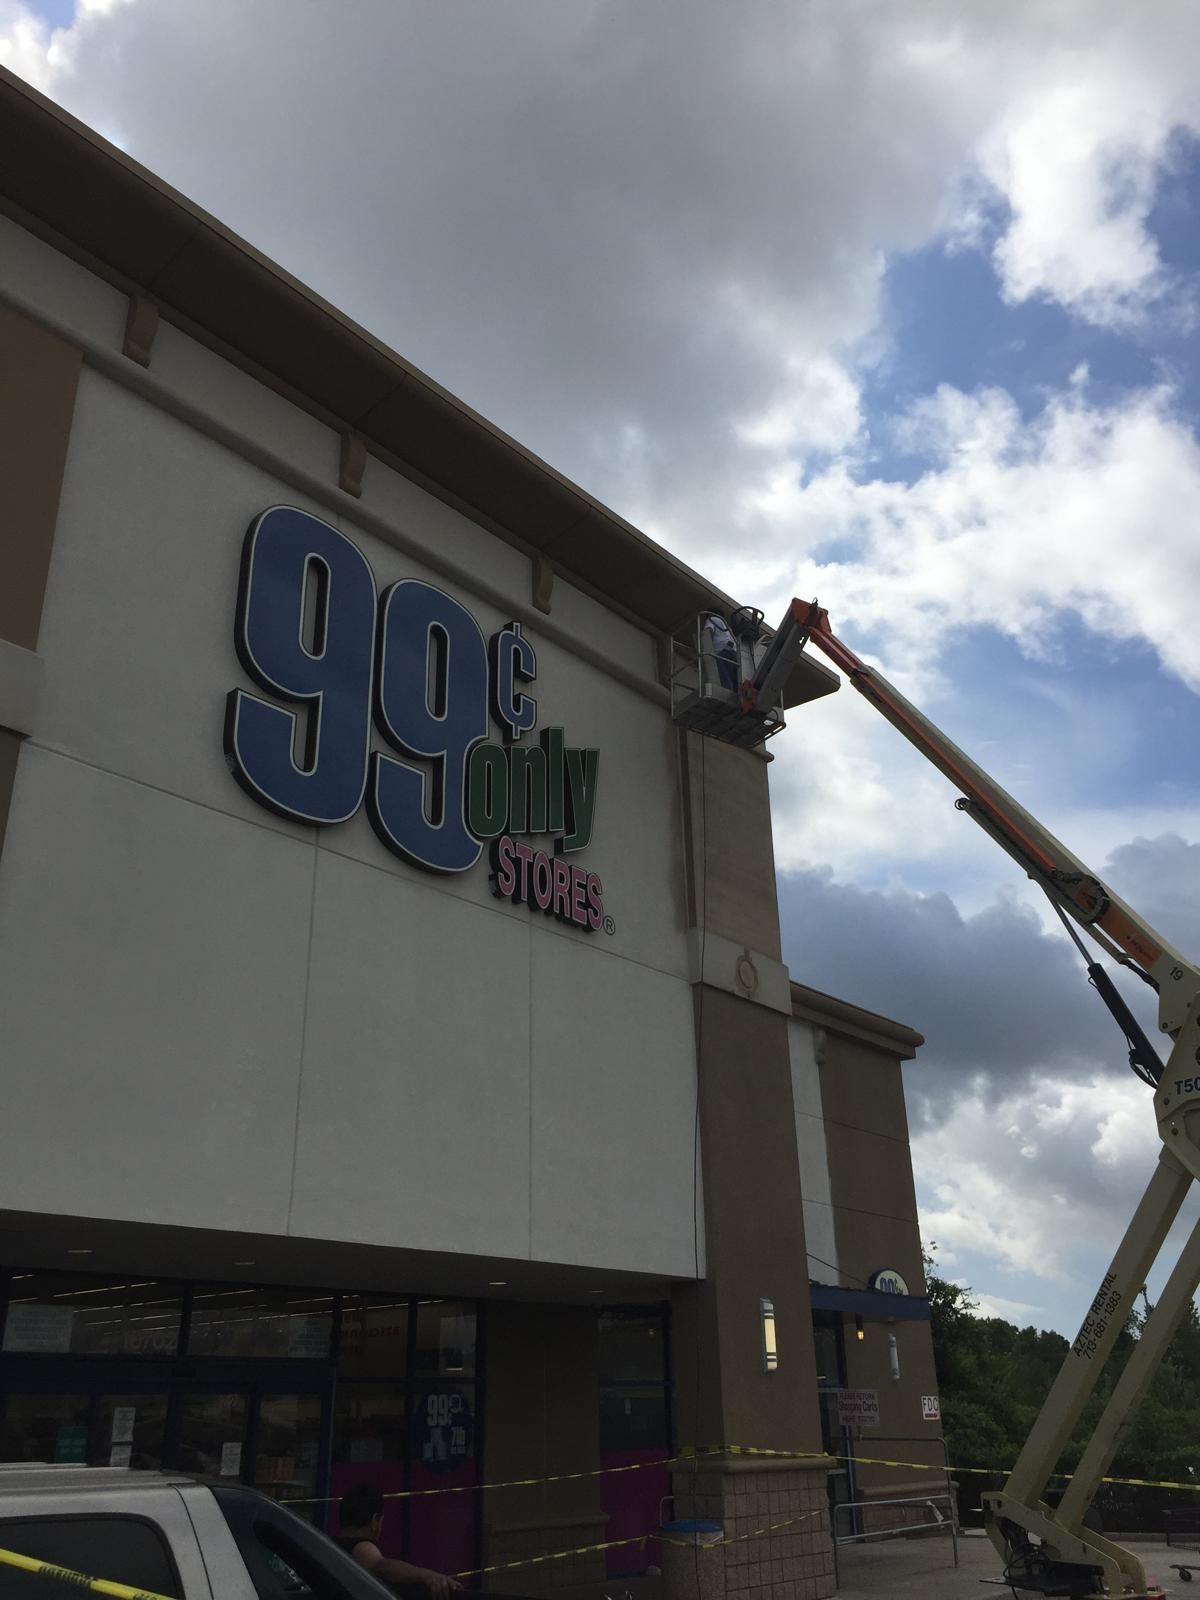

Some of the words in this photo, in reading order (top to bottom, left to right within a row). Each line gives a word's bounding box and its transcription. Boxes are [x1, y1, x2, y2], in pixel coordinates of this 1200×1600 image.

[466, 727, 599, 853] only
[1169, 966, 1184, 981] 19
[1073, 1316, 1096, 1358] AZTEC
[1091, 1272, 1117, 1315] RENTAL
[862, 1400, 878, 1413] Carts
[922, 1397, 939, 1411] FDC
